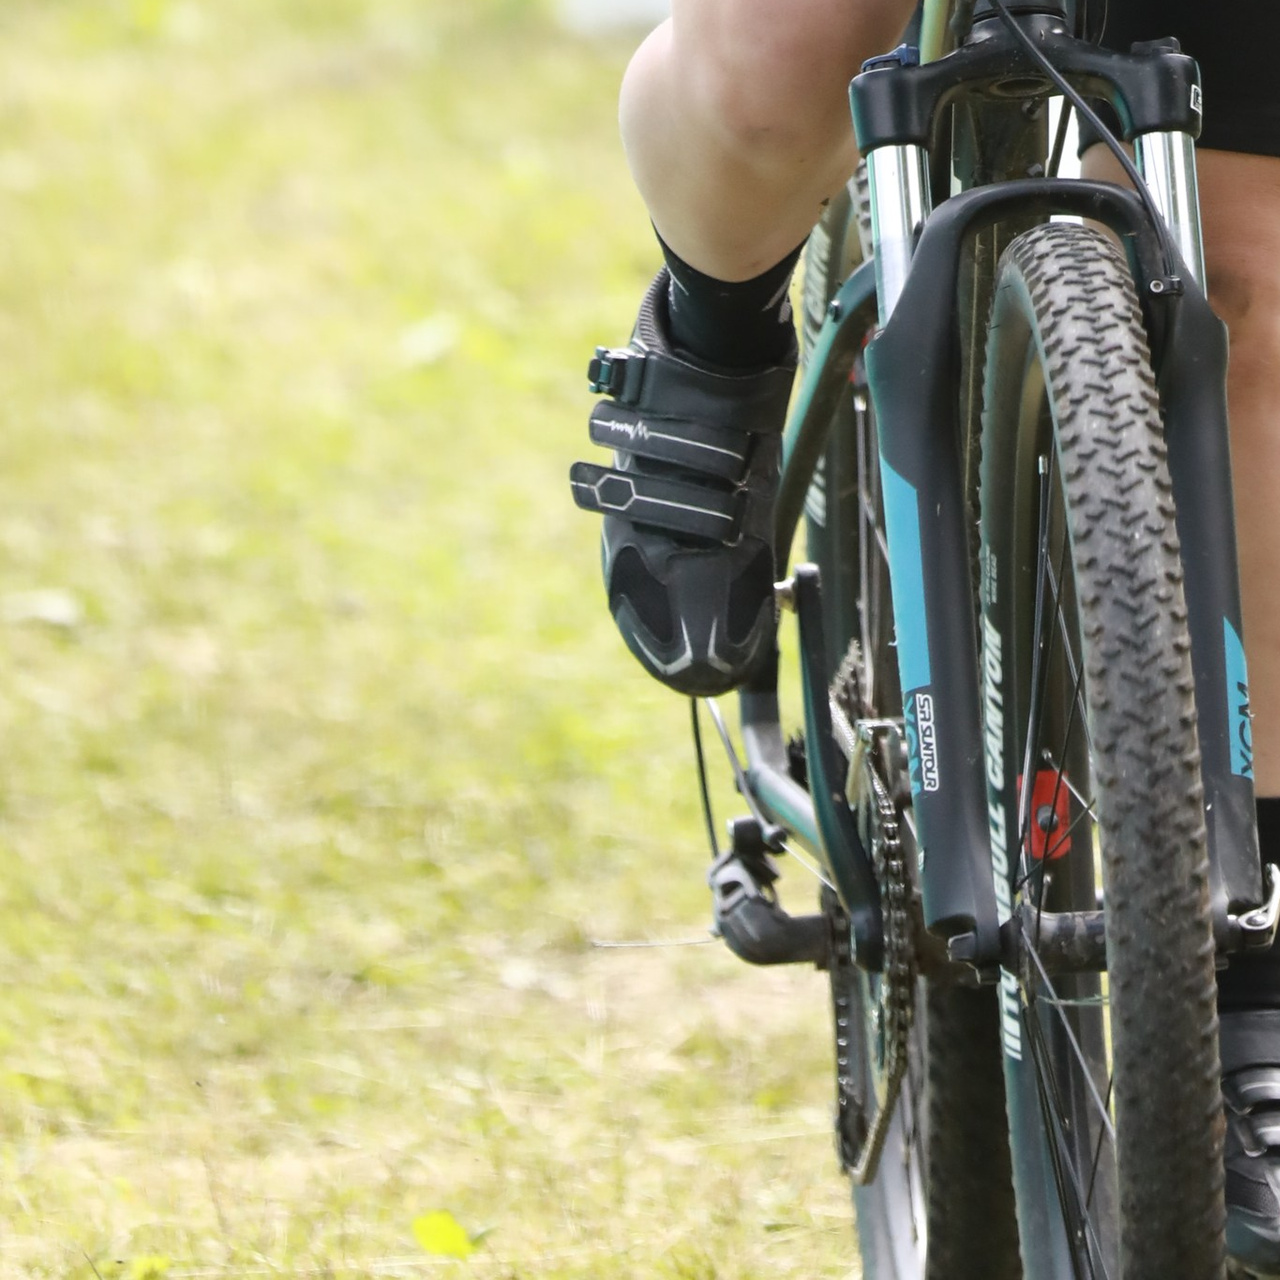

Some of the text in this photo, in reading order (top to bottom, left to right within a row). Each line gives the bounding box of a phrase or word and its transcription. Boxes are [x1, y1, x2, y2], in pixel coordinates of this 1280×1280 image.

[917, 696, 937, 790] SR SUNTOUR
[983, 614, 1005, 791] CANYON
